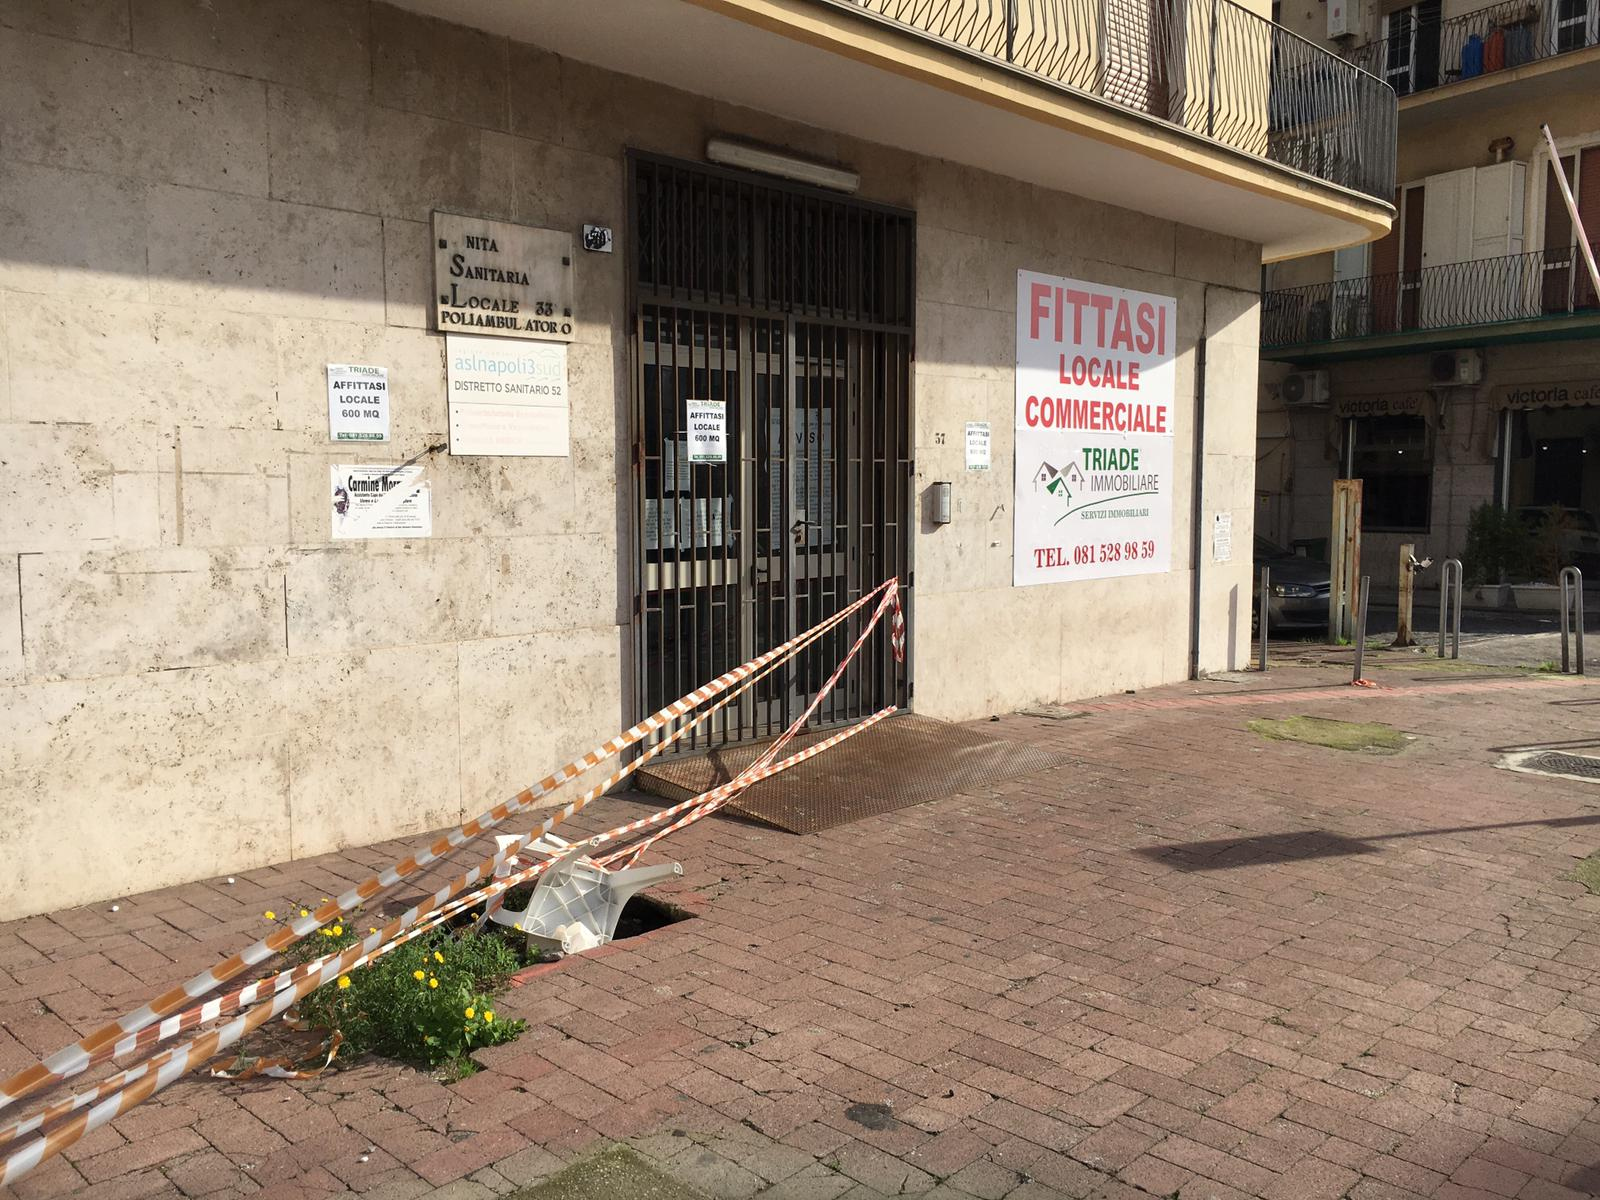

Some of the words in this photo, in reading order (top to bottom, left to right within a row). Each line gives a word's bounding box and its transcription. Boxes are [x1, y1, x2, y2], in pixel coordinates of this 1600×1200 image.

[466, 236, 499, 252] NITA
[1030, 282, 1166, 356] FITTASI
[348, 366, 380, 375] TRIADE
[1059, 354, 1140, 391] LOCALE
[333, 381, 386, 391] AFFITTASI
[454, 380, 503, 393] DISTRETTO
[505, 383, 550, 395] SANITARIO
[552, 386, 562, 396] 52
[340, 395, 380, 405] LOCALE
[1506, 386, 1569, 405] victoria
[1339, 397, 1388, 413] victoria
[342, 409, 361, 418] 600
[363, 409, 380, 419] MQ
[690, 412, 724, 420] AFFITTASI
[1025, 395, 1166, 433] COMMERCIALE
[694, 423, 721, 431] LOCALE
[694, 434, 708, 442] 600
[1082, 448, 1140, 471] TRIADE
[348, 475, 380, 492] Carmine
[1091, 474, 1159, 492] IMMOBILIARE
[1080, 510, 1107, 520] SERVIZI
[1108, 508, 1149, 519] IMMOBILIARI
[1034, 547, 1070, 568] TEL.
[1074, 545, 1095, 565] 081
[1100, 543, 1121, 562] 528
[1124, 541, 1138, 561] 98
[1141, 540, 1155, 559] 59
